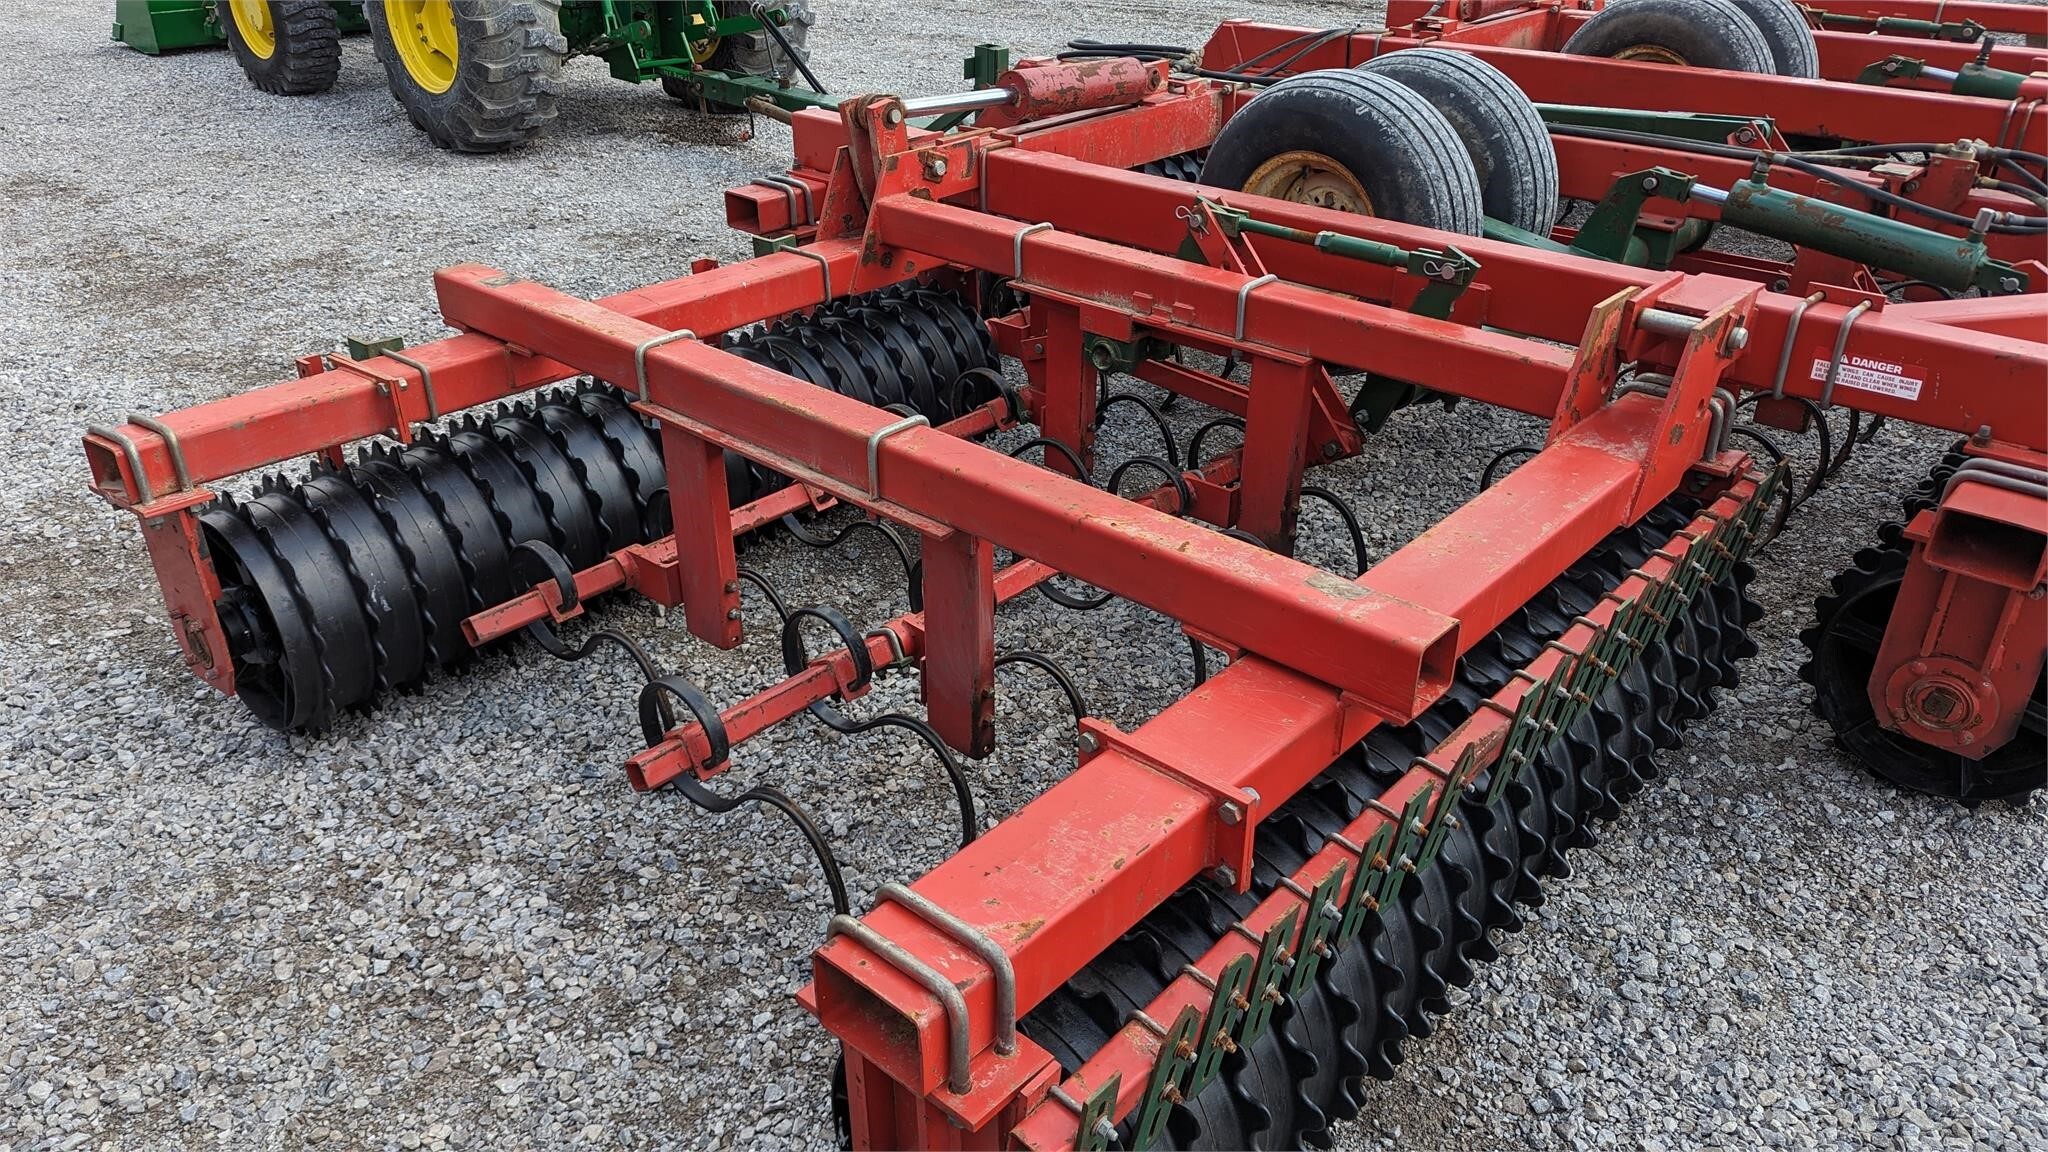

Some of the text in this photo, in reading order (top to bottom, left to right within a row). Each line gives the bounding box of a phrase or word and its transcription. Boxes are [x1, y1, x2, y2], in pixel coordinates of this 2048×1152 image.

[1851, 356, 1903, 375] DANGER
[1841, 366, 1859, 374] WINGS
[1877, 374, 1895, 383] CAUSE
[1898, 378, 1918, 387] INJURY
[1841, 378, 1860, 387] RAISED
[1843, 372, 1861, 381] STAND
[1862, 376, 1880, 385] CLEAR
[1881, 381, 1898, 389] WHEN
[1899, 384, 1917, 393] WINGS
